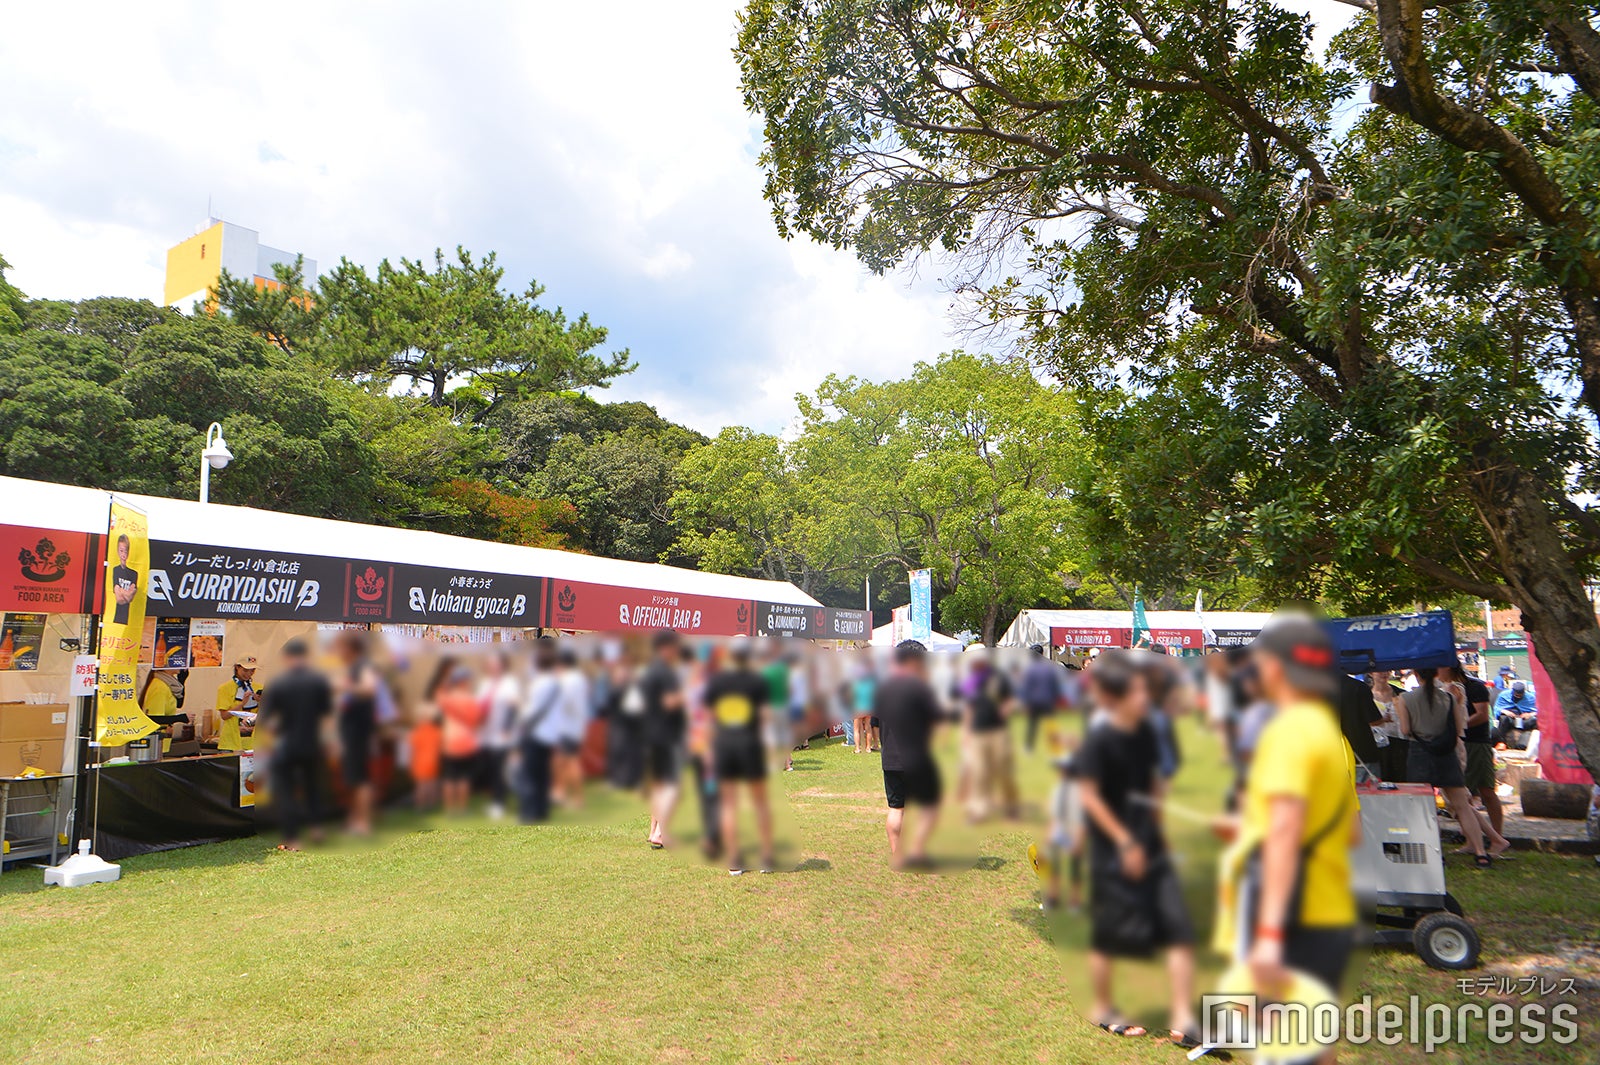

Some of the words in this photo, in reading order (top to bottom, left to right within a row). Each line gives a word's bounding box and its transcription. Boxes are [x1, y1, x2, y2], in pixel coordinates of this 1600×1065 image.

[177, 572, 297, 604] CURRYDASHI
[449, 576, 493, 589] 小春ぎょうざ
[17, 591, 41, 602] FOOD
[43, 593, 65, 603] AREA
[216, 602, 260, 614] KOKURAKITA
[428, 588, 474, 614] koharu
[473, 597, 510, 619] gyoza
[355, 607, 368, 615] FOOD
[632, 605, 670, 627] OFFICIAL
[672, 609, 691, 629] BAR
[1347, 620, 1379, 632] Air
